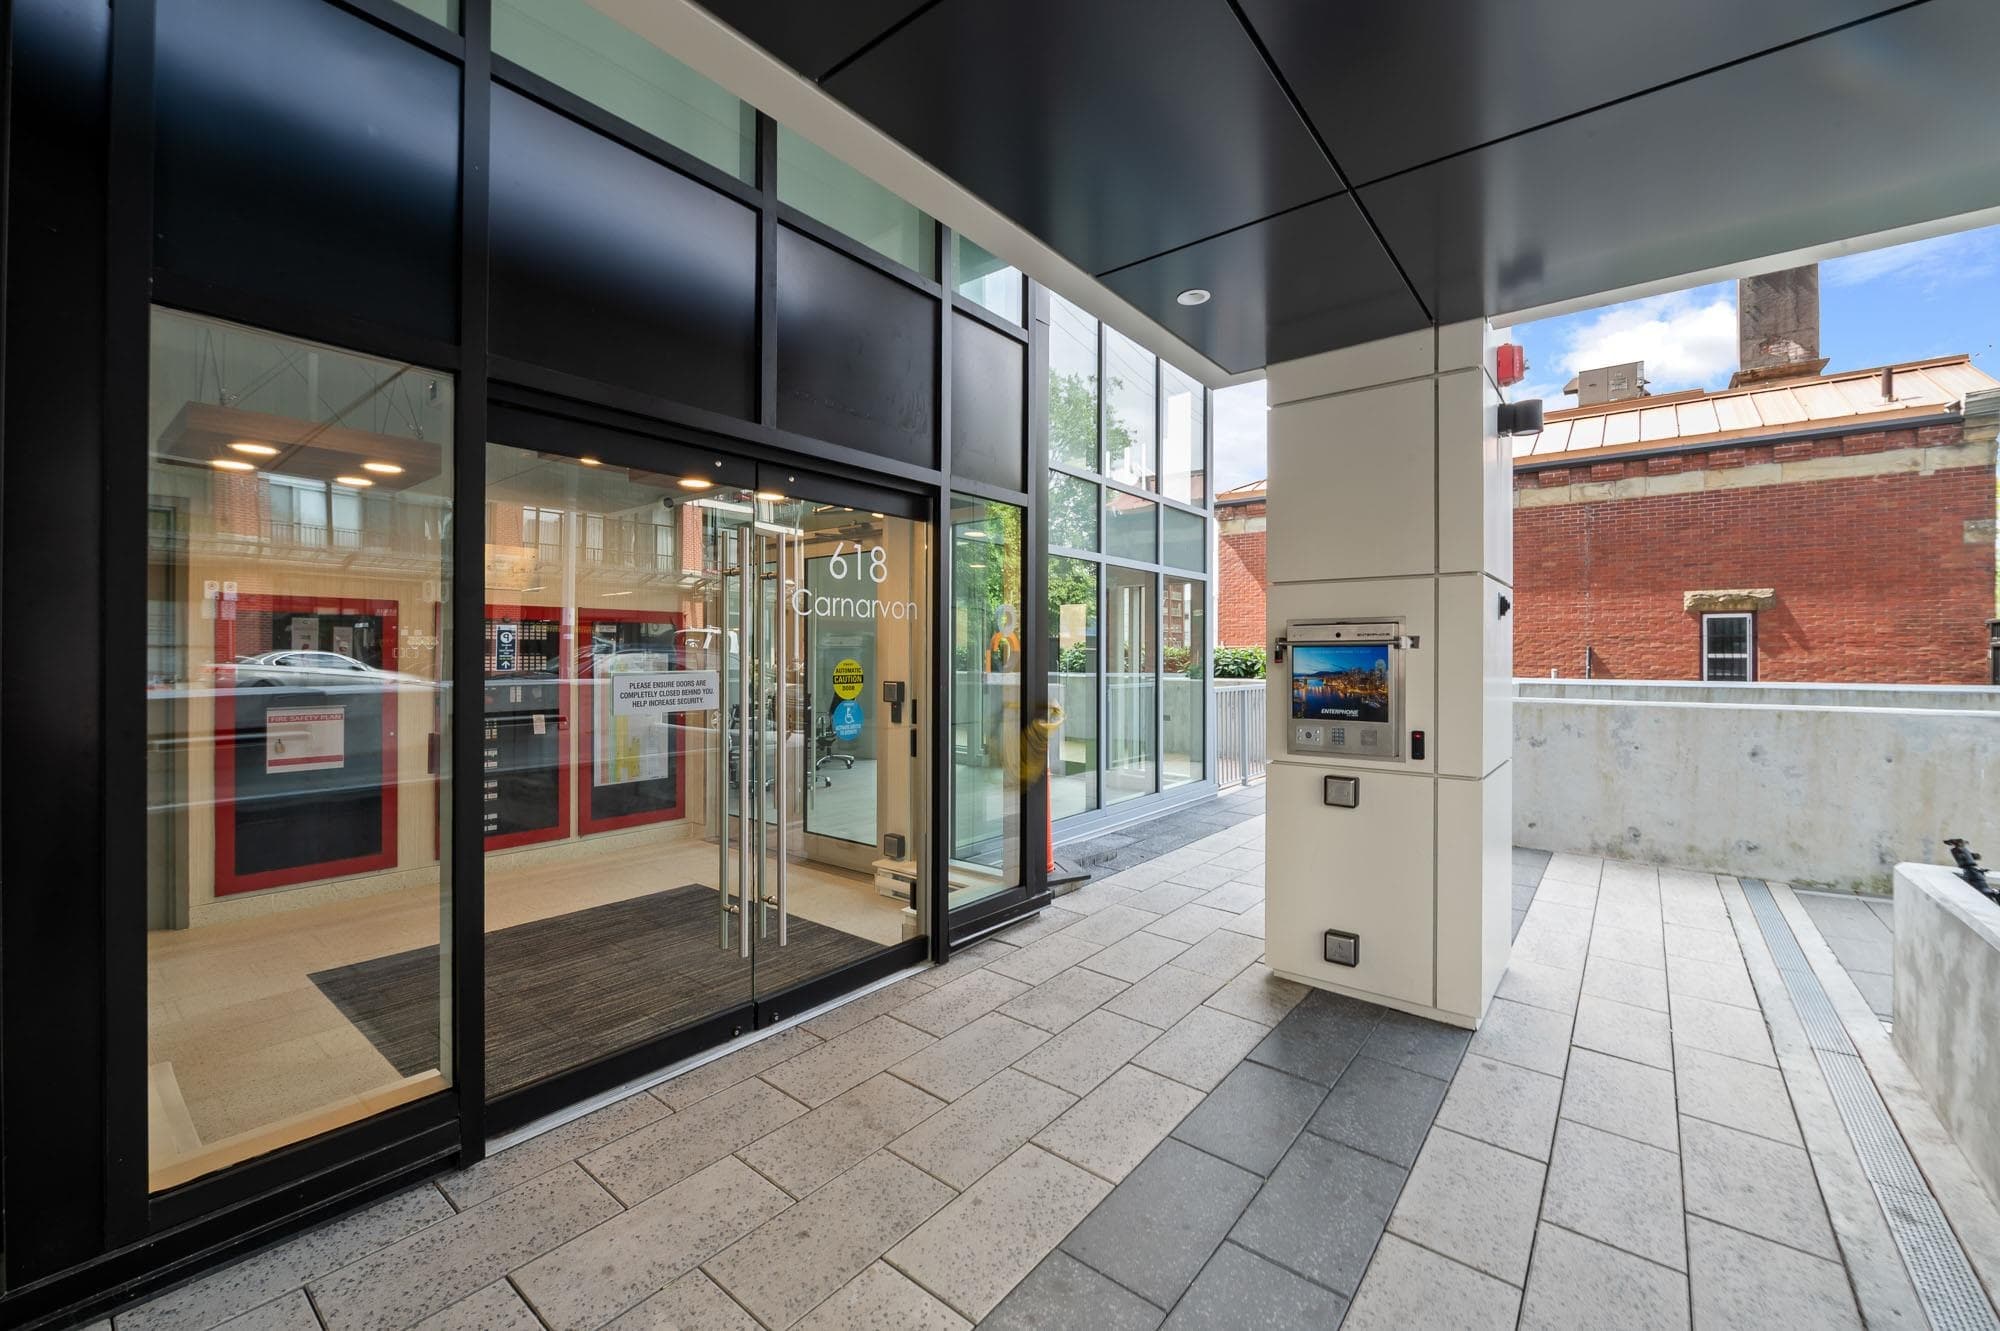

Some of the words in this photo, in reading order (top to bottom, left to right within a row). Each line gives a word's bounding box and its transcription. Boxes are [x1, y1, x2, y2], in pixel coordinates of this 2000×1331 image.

[829, 541, 888, 583] 618
[792, 588, 918, 620] Carnarvon
[629, 681, 651, 690] PLEASE
[652, 680, 674, 689] ENSURE
[676, 680, 695, 688] DOORS
[695, 679, 706, 687] ARE
[834, 675, 862, 683] CAUTION
[620, 690, 657, 699] COMPLETELY
[659, 689, 680, 697] CLOSED
[681, 688, 702, 696] BEHIND
[632, 700, 648, 708] HELP
[648, 698, 676, 707] INCREASE
